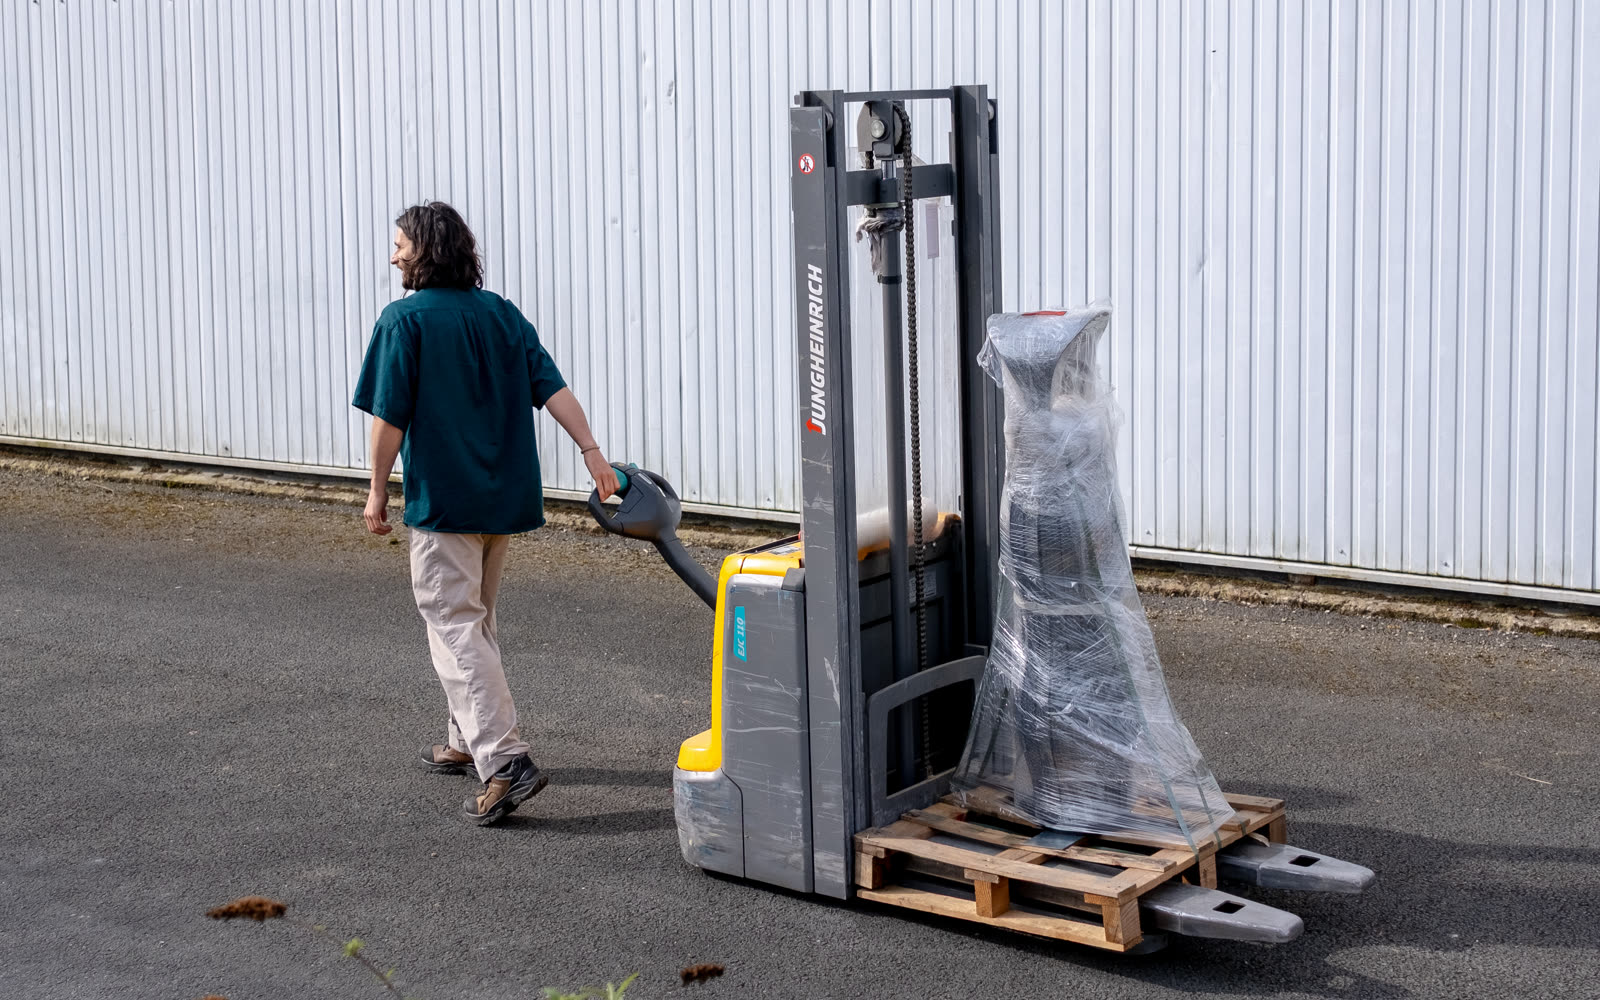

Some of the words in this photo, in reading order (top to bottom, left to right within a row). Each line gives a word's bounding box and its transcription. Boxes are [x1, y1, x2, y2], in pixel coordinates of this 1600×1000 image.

[806, 263, 827, 436] JUNGHEINRICH
[736, 616, 745, 637] 110
[737, 637, 745, 657] EJC
